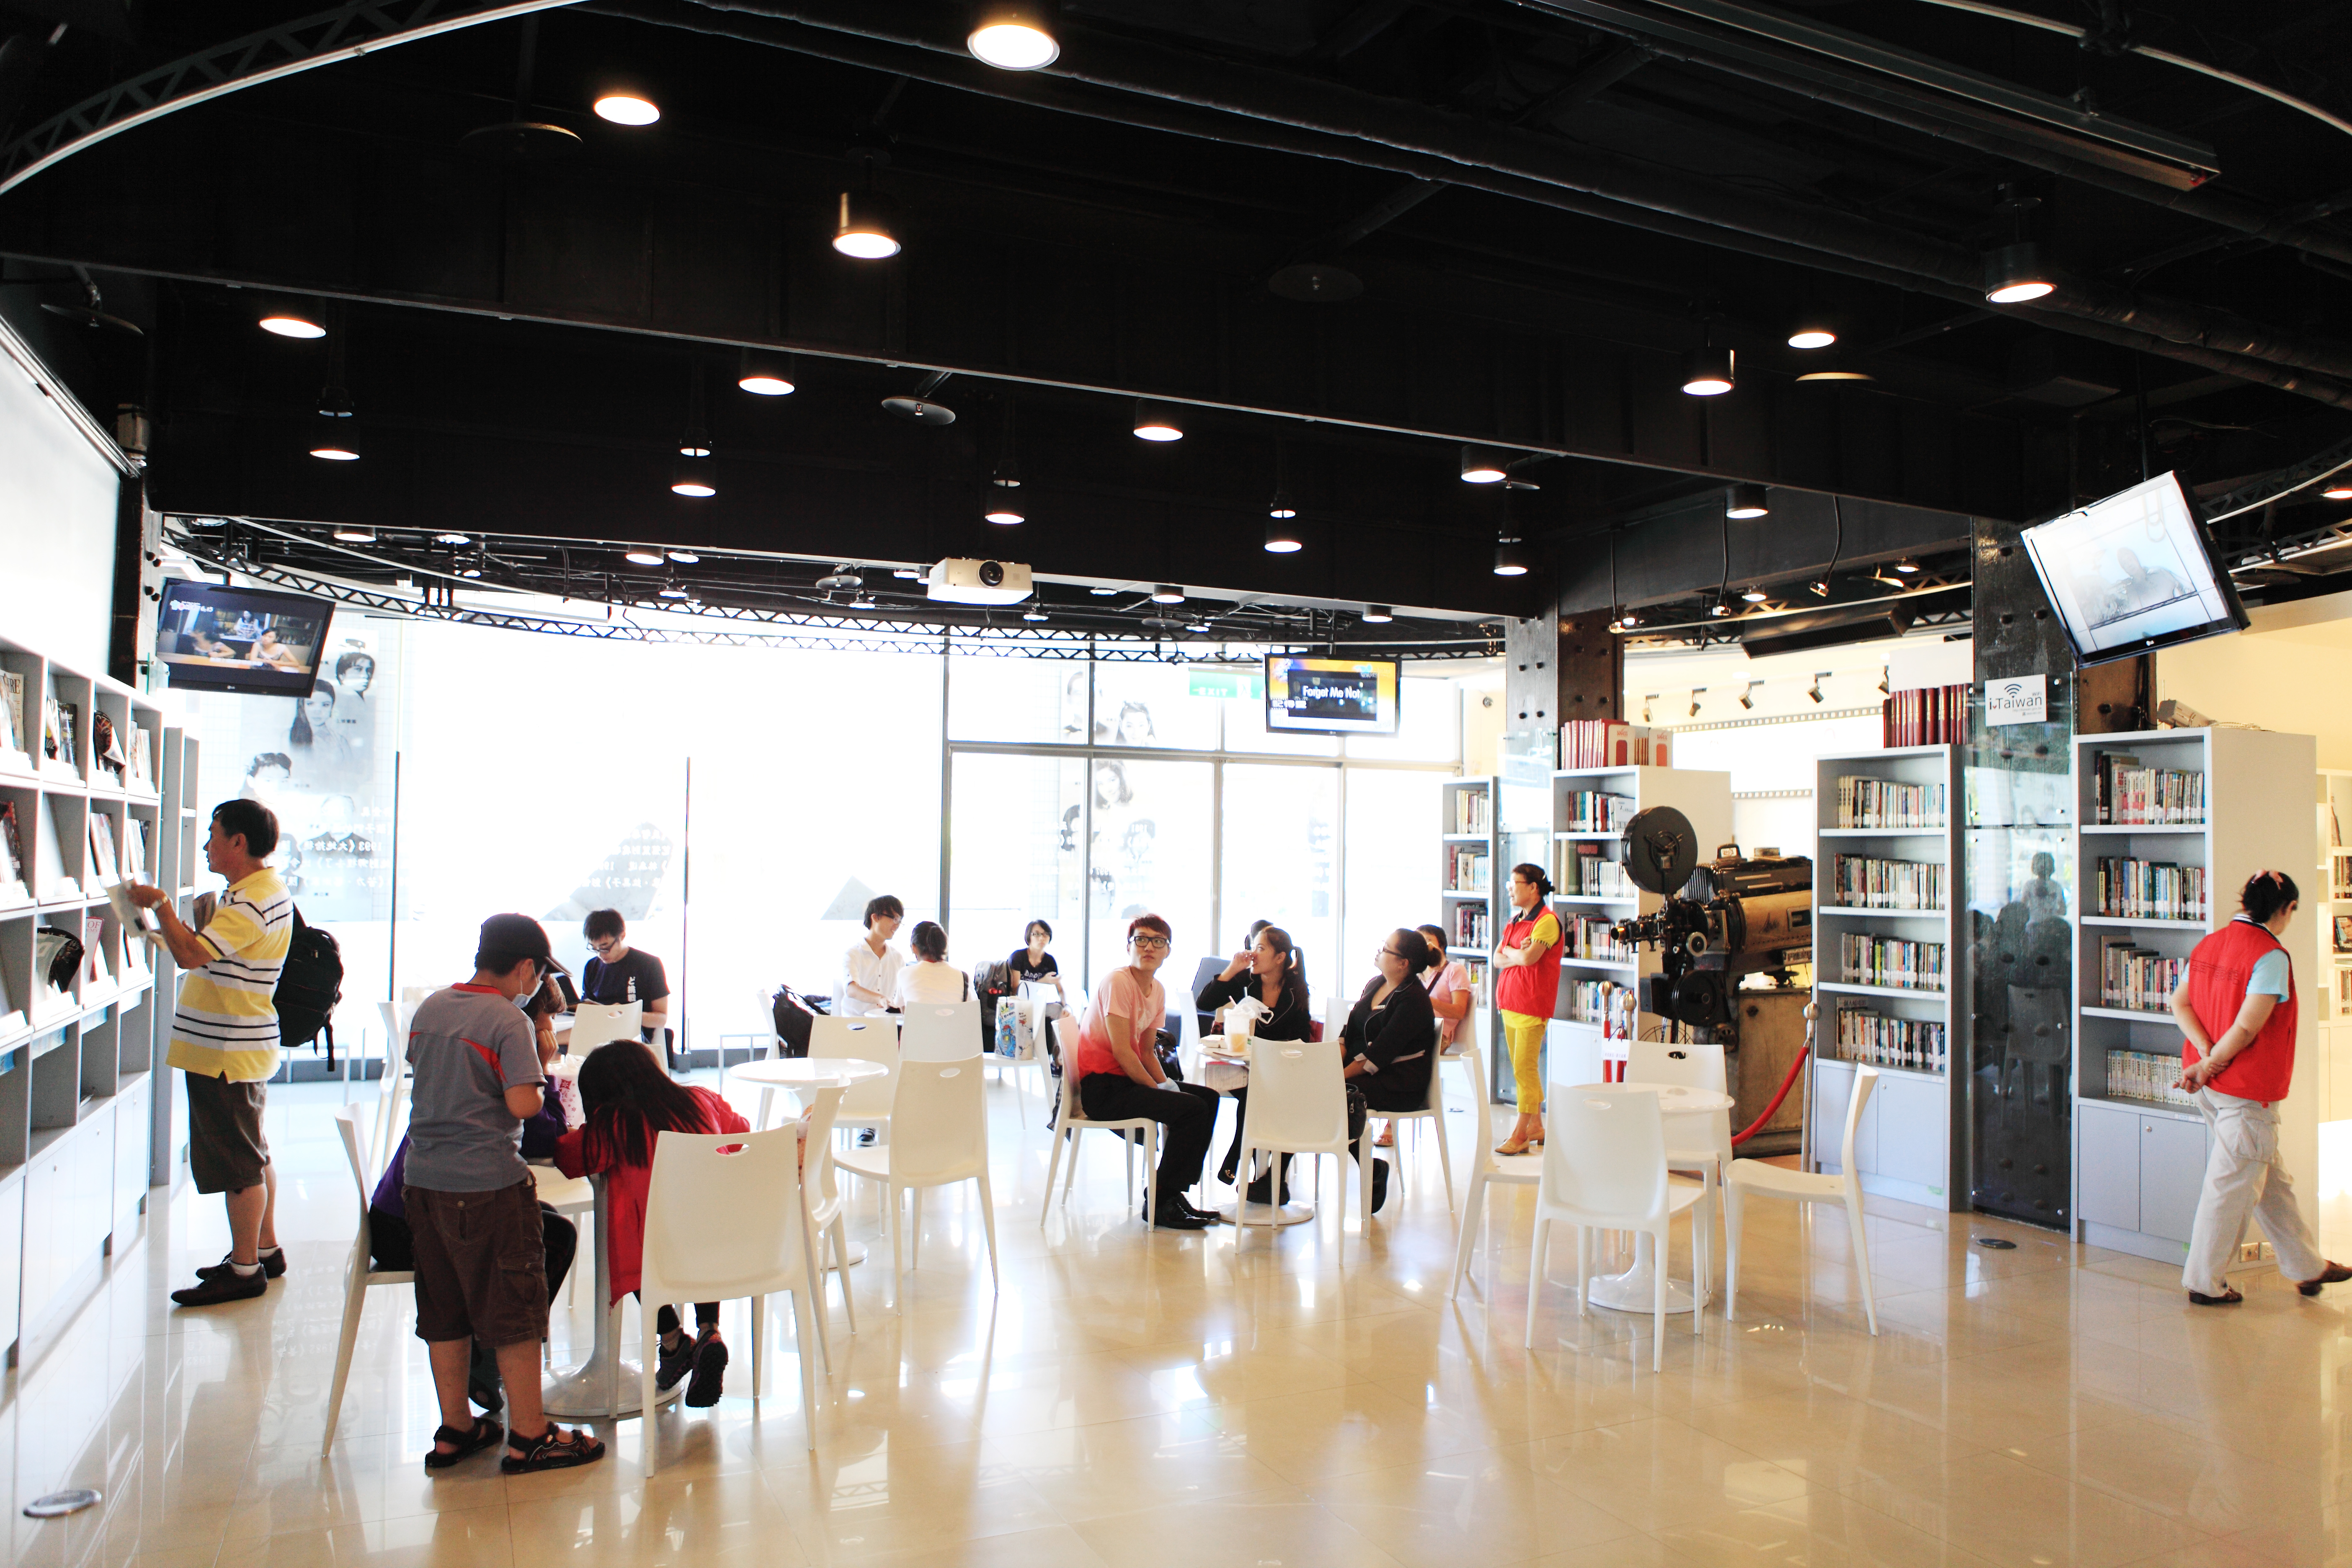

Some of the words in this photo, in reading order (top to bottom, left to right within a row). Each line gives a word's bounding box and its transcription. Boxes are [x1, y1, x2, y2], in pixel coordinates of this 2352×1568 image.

[1199, 687, 1228, 696] EXIT
[1302, 685, 1328, 699] Forget
[1330, 686, 1344, 698] Me
[1345, 686, 1361, 699] Not
[1024, 969, 1042, 980] DROP
